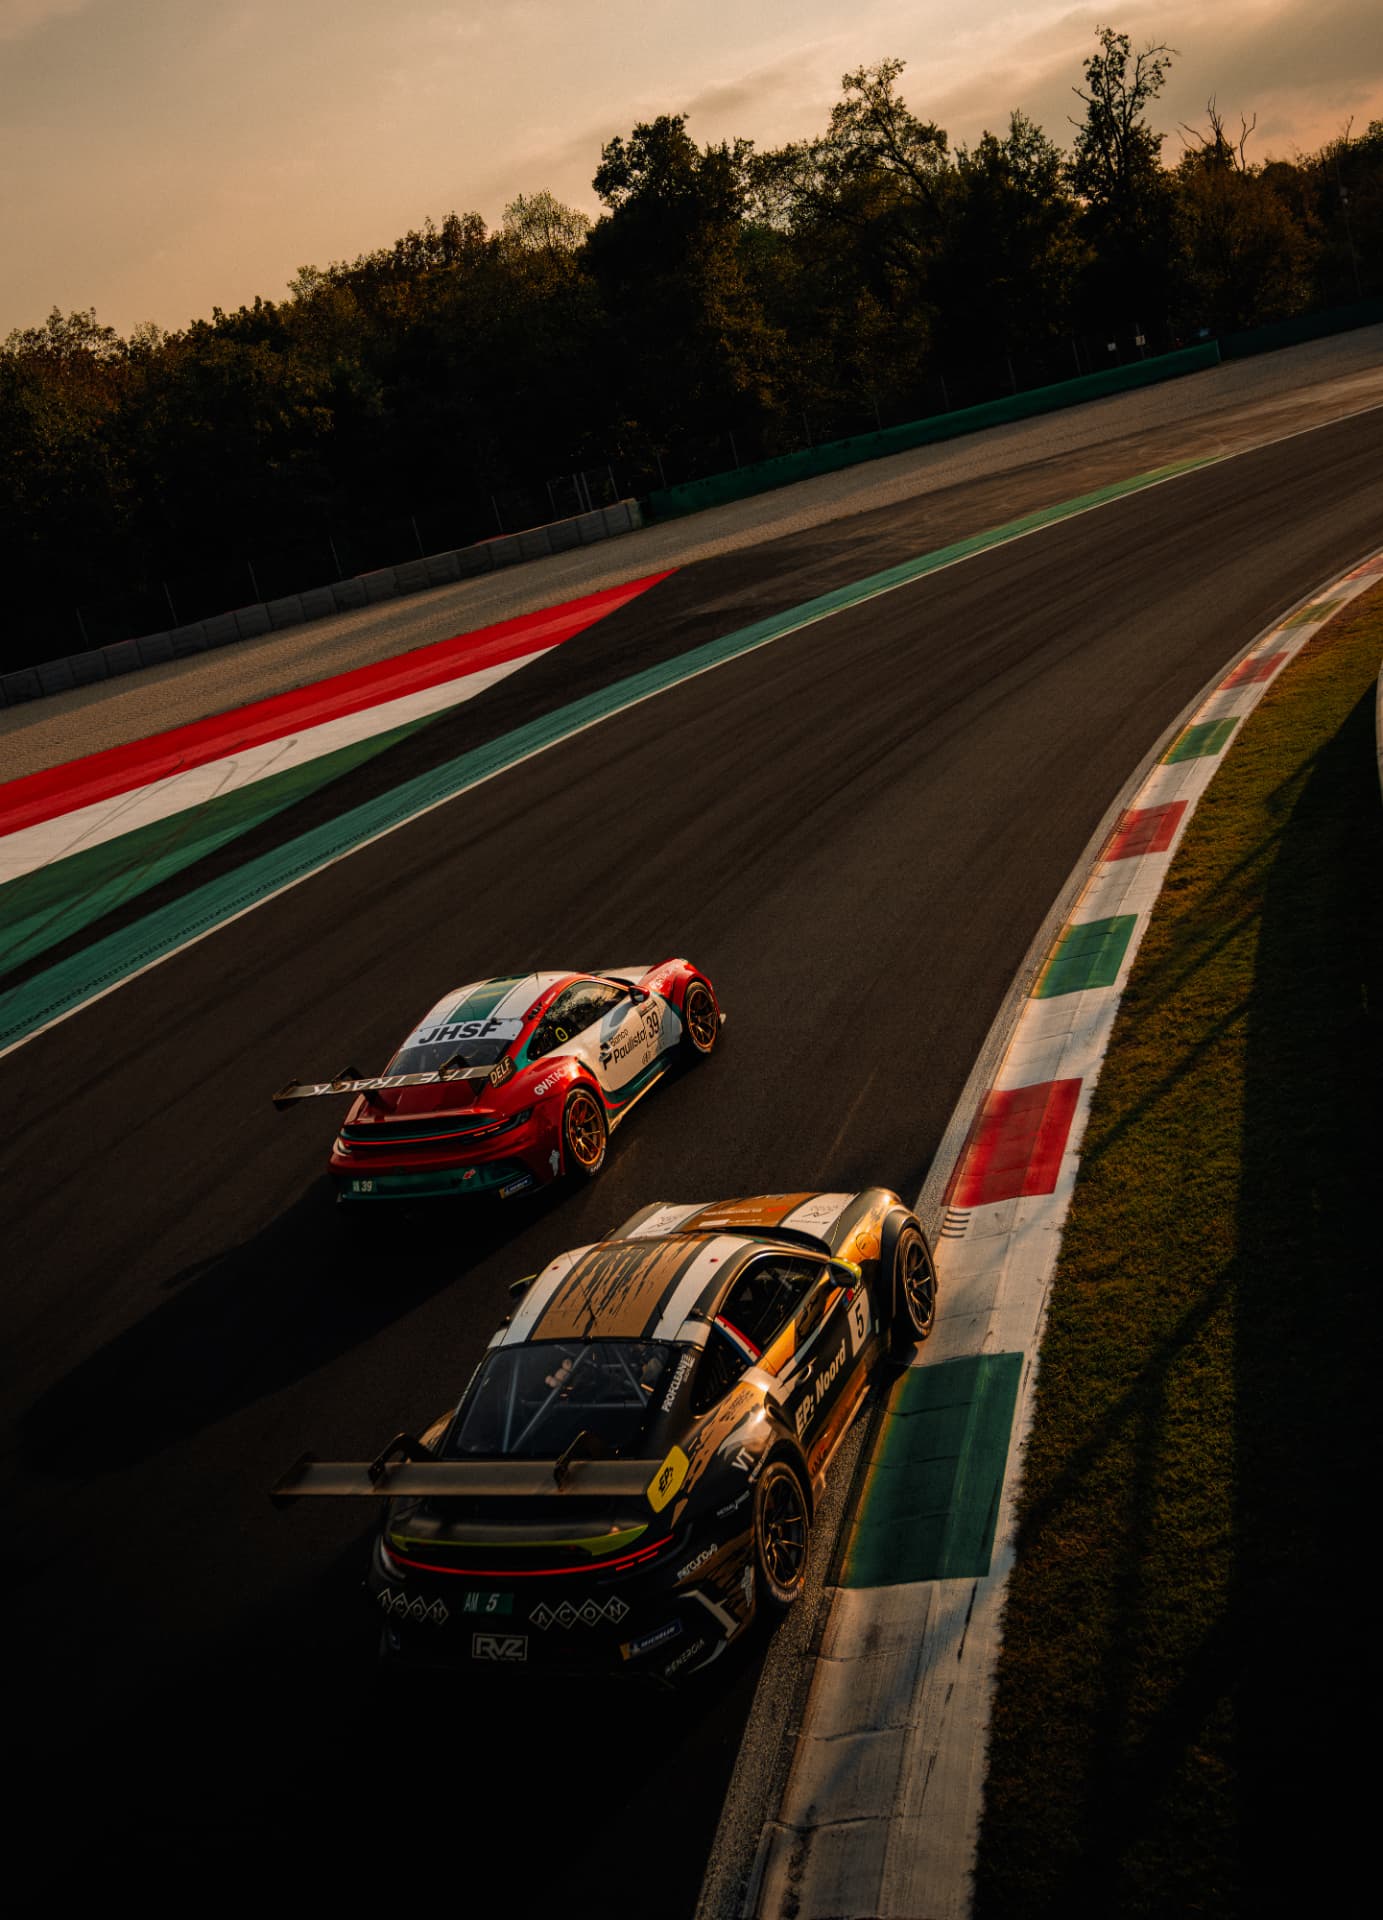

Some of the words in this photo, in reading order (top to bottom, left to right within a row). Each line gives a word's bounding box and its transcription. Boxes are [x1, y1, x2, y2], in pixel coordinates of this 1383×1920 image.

[419, 1020, 501, 1044] JHSF
[646, 1011, 660, 1039] 39
[612, 1029, 647, 1064] Paulista
[490, 1058, 512, 1085] DELF
[361, 1181, 373, 1192] 39
[855, 1303, 864, 1338] 5
[815, 1338, 847, 1404] Noord
[731, 1447, 755, 1472] VT
[486, 1591, 501, 1611] 5
